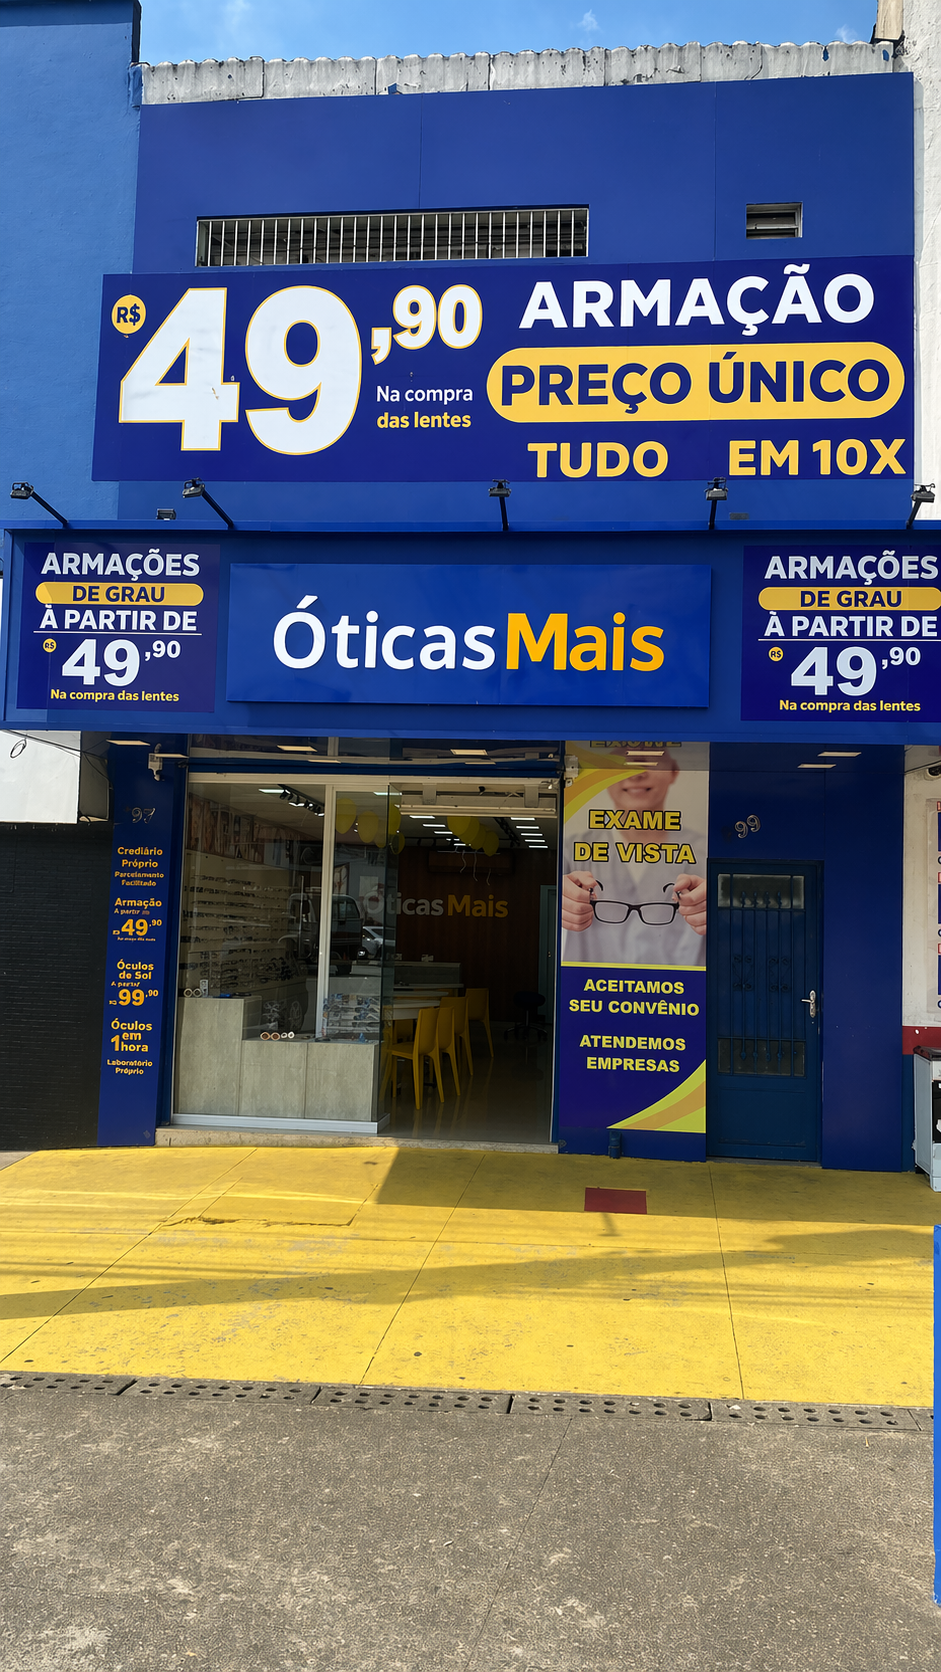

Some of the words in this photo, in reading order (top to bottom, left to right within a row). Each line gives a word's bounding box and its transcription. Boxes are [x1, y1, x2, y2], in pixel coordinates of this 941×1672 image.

[518, 263, 875, 336] ARMAÇÃO
[116, 303, 141, 326] R$
[501, 362, 692, 414] PREÇO
[708, 351, 890, 403] ÚNICO
[376, 385, 400, 402] Na
[404, 388, 473, 405] compra
[376, 411, 411, 429] das
[413, 411, 472, 429] lentes
[527, 440, 669, 478] TUDO
[728, 439, 799, 476] EM
[812, 438, 906, 476] 10X
[40, 548, 200, 581] ARMAÇÕES
[764, 550, 939, 585] ARMAÇÕES
[72, 586, 100, 602] DE
[105, 586, 165, 603] GRAU
[800, 590, 830, 607] DE
[836, 590, 902, 608] GRAU
[64, 609, 157, 631] PARTIR
[163, 611, 198, 631] DE
[792, 615, 894, 637] PARTIR
[900, 615, 938, 637] DE
[273, 594, 496, 671] Óticas
[506, 610, 665, 672] Mais
[50, 689, 67, 700] Na
[69, 691, 115, 702] compra
[117, 690, 139, 701] das
[141, 690, 179, 702] lentes
[779, 700, 797, 710] Na
[800, 702, 851, 713] compra
[853, 700, 877, 711] das
[879, 700, 921, 711] lentes
[588, 809, 681, 831] EXAME
[734, 814, 761, 838] 99
[117, 846, 163, 856] Crediário
[573, 842, 609, 862] DE
[615, 842, 697, 864] VISTA
[121, 859, 159, 869] Próprio
[114, 897, 162, 909] Armação
[364, 884, 444, 917] Óticas
[447, 894, 509, 918] Mais
[117, 958, 154, 970] Óculos
[118, 970, 132, 980] de
[134, 971, 152, 980] Sol
[583, 979, 685, 995] ACEITAMOS
[569, 999, 603, 1013] SEU
[608, 1000, 700, 1016] CONVÊNIO
[111, 1017, 153, 1031] Óculos
[110, 1034, 120, 1052] 1
[121, 1041, 149, 1052] hora
[122, 1032, 142, 1041] em
[579, 1034, 686, 1051] ATENDEMOS
[586, 1056, 680, 1073] EMPRESAS
